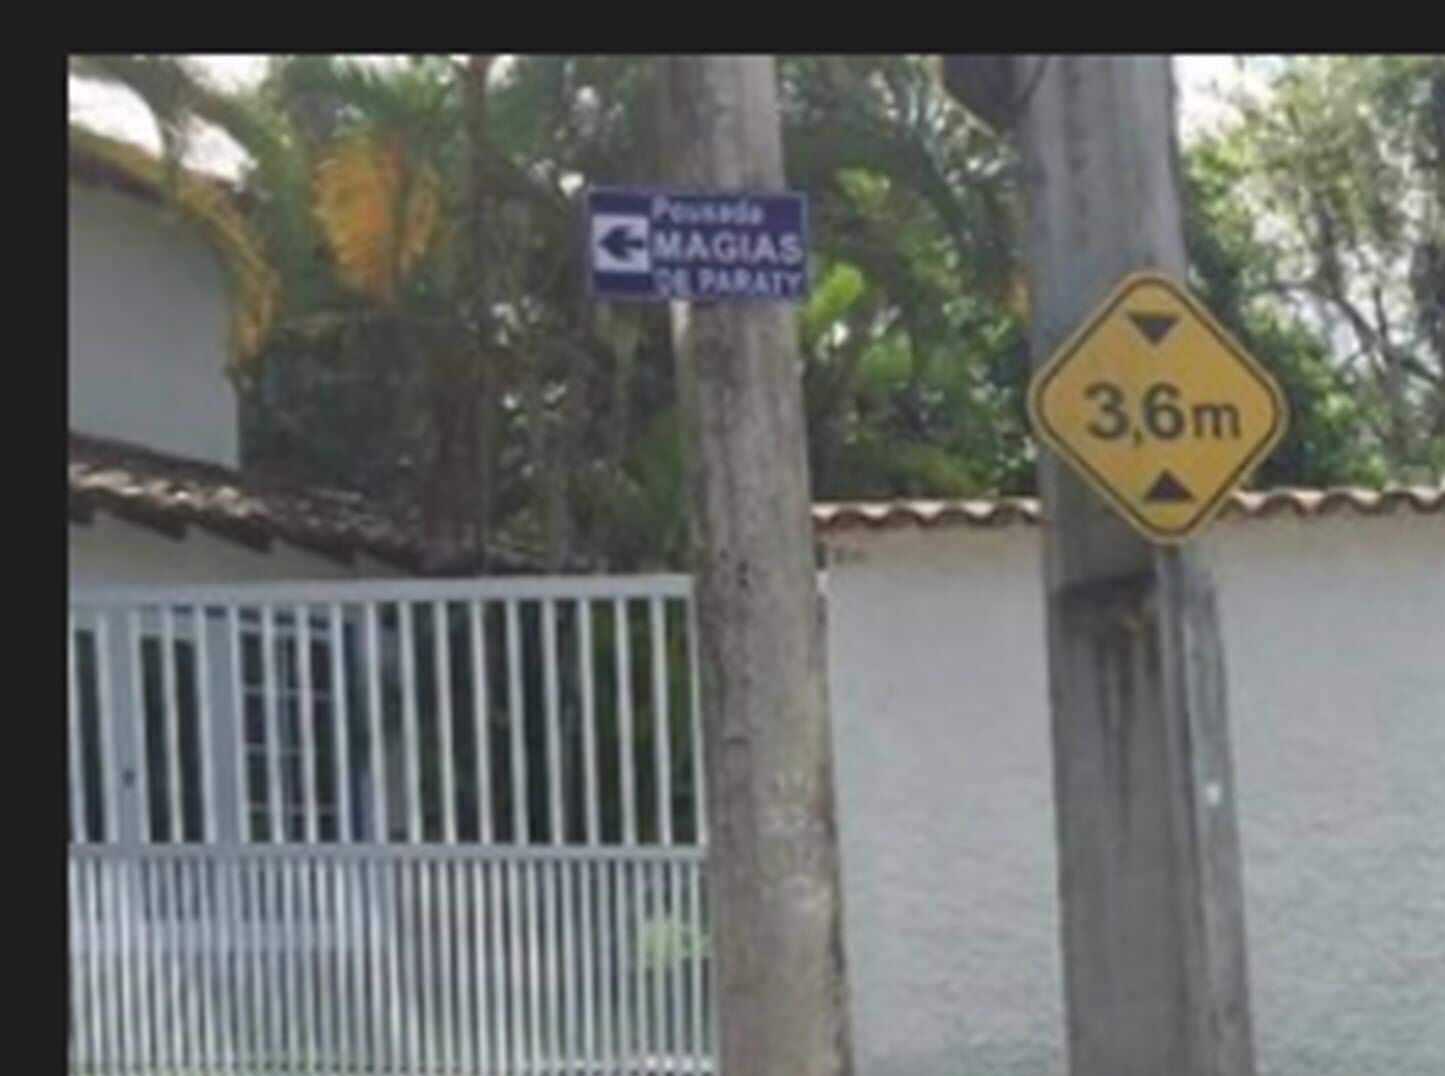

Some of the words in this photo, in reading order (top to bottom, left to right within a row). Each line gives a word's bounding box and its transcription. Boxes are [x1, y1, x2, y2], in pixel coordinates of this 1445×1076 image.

[655, 231, 803, 266] MAGIAS
[699, 269, 802, 294] PARATY
[1083, 381, 1243, 446] 3,6m
